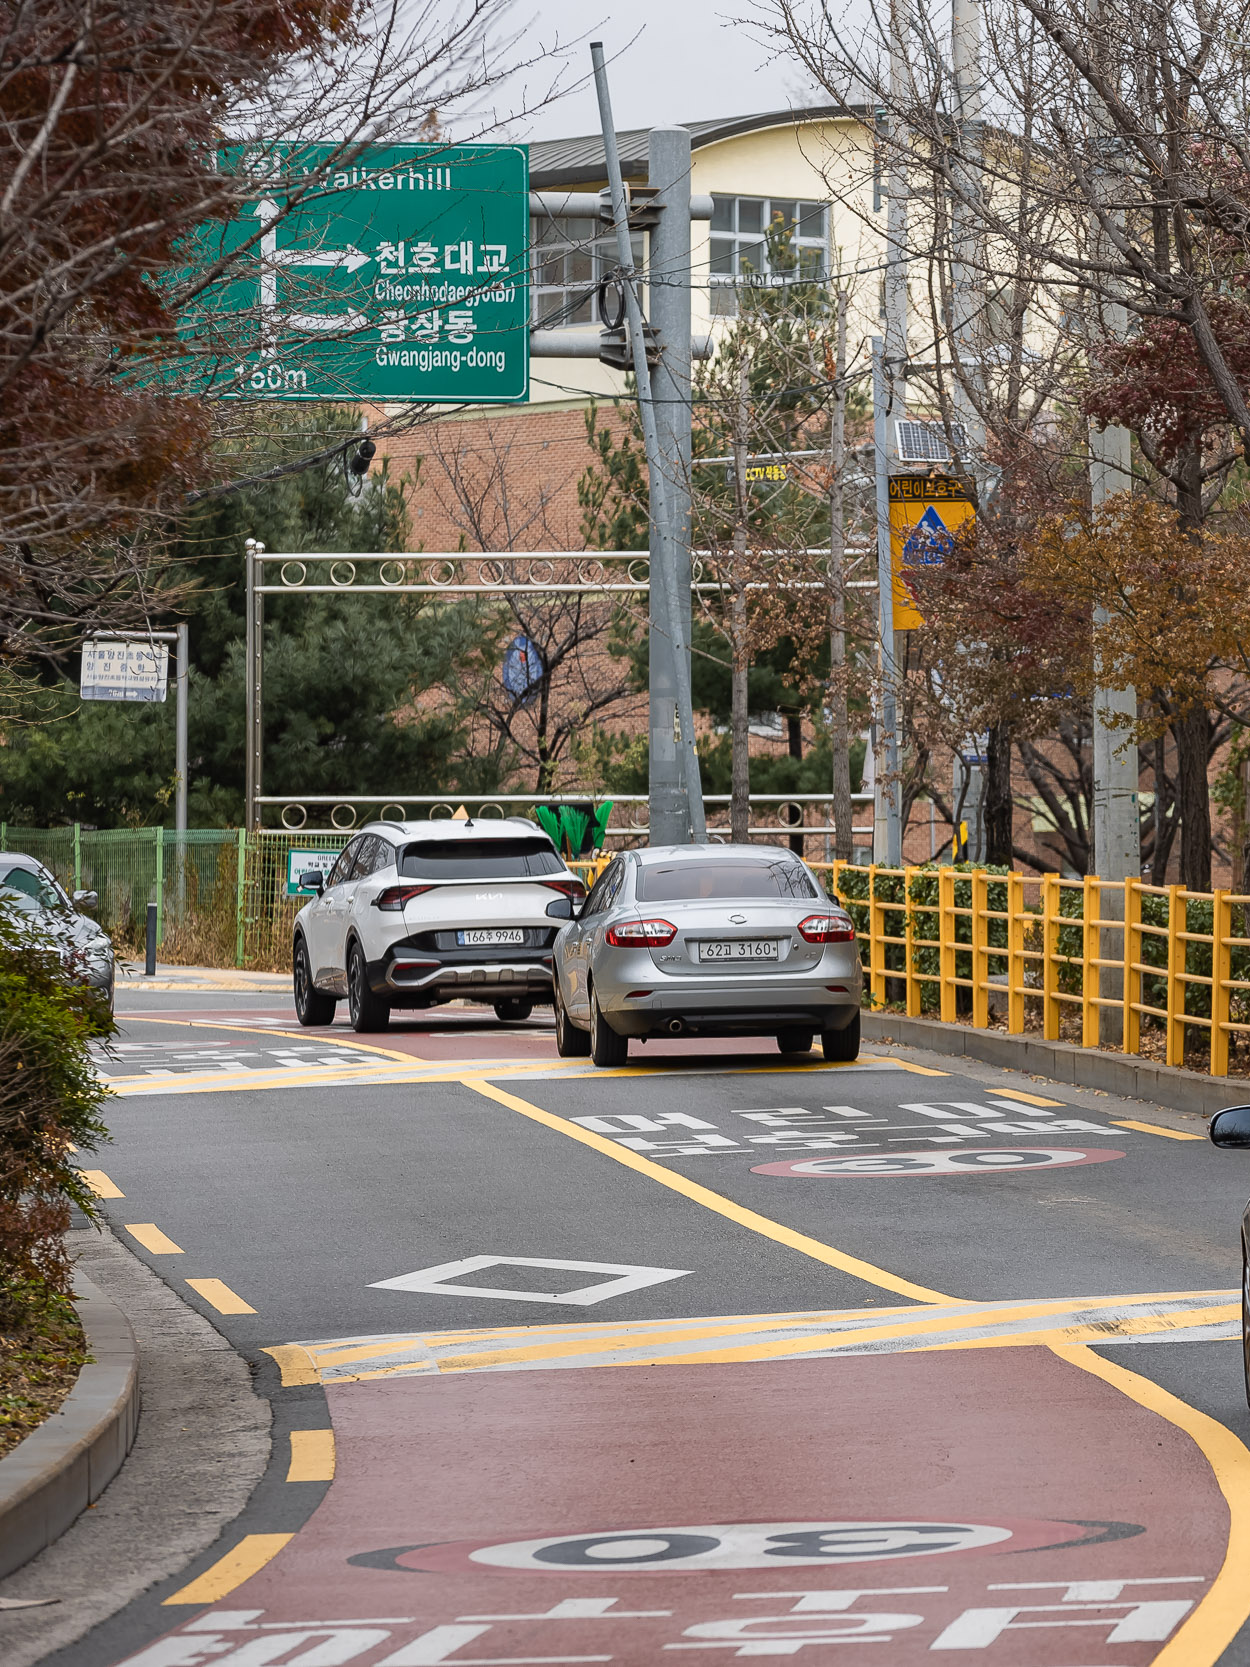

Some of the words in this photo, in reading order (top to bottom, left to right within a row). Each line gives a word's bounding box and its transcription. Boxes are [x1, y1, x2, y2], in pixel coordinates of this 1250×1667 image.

[374, 241, 510, 275] 천호대교
[374, 279, 516, 307] Cheonhodaegyo(Br)
[376, 308, 478, 344] 광장동
[375, 346, 506, 372] Gwangjang-dong
[889, 479, 966, 498] 어린이보호구
[495, 930, 522, 942] 9946
[738, 942, 771, 956] 3160
[812, 1151, 1053, 1173] 30
